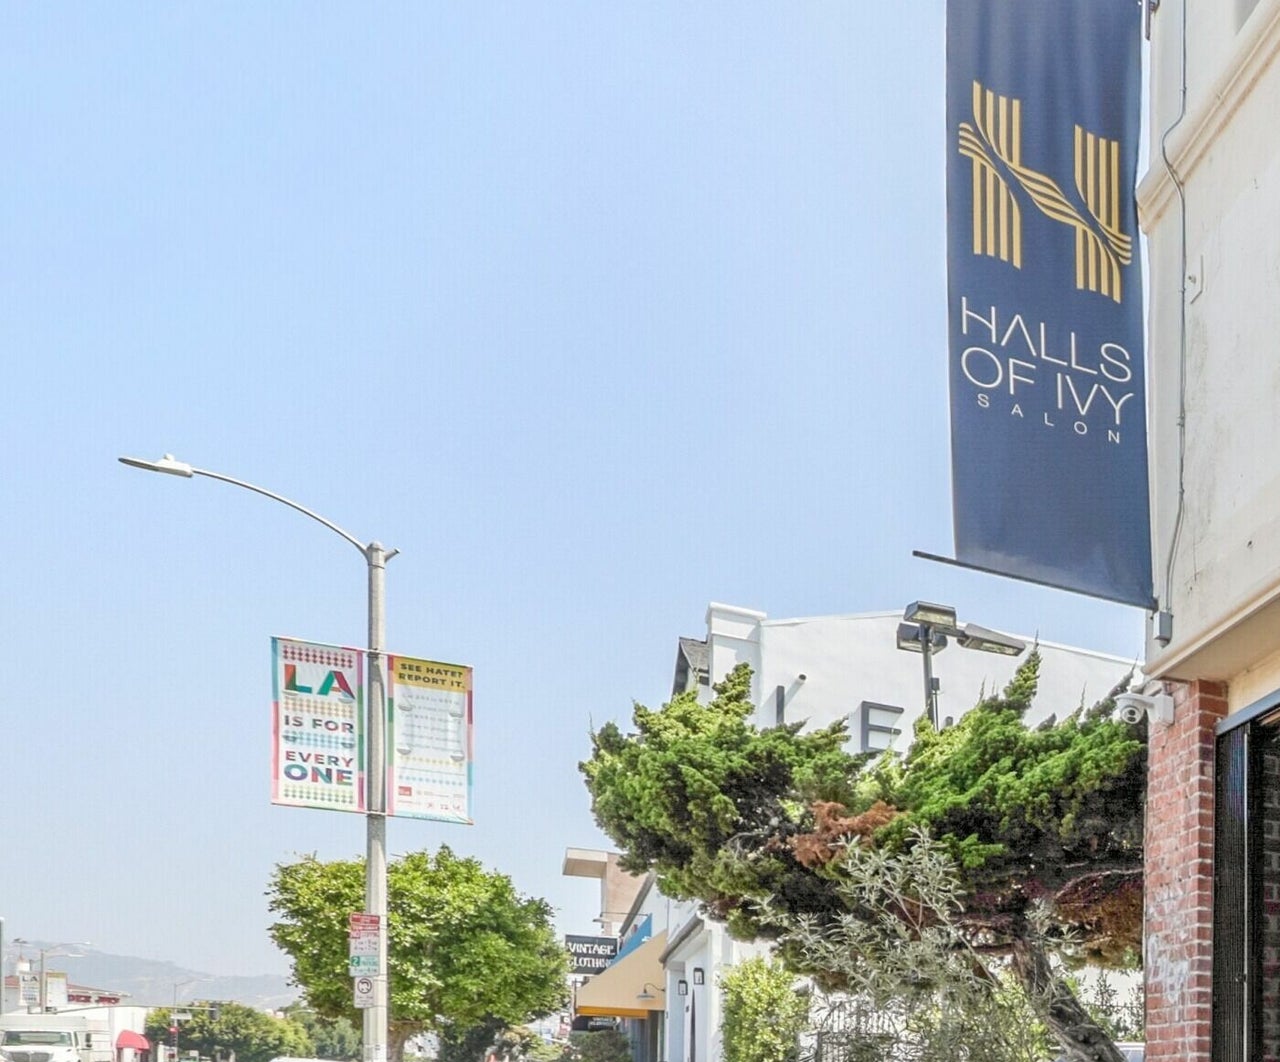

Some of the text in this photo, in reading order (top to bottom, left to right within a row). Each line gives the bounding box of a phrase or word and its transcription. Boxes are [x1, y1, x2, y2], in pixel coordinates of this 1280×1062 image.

[961, 296, 1132, 382] HALLS
[961, 347, 1134, 425] OF IVY
[977, 393, 1120, 444] SALON
[400, 663, 422, 673] SEE
[284, 663, 356, 700] LA
[398, 673, 447, 685] REPORT
[284, 714, 355, 733] IS FOR
[285, 750, 354, 767] EVERY
[283, 763, 354, 786] ONE
[567, 942, 616, 955] VINTAGE
